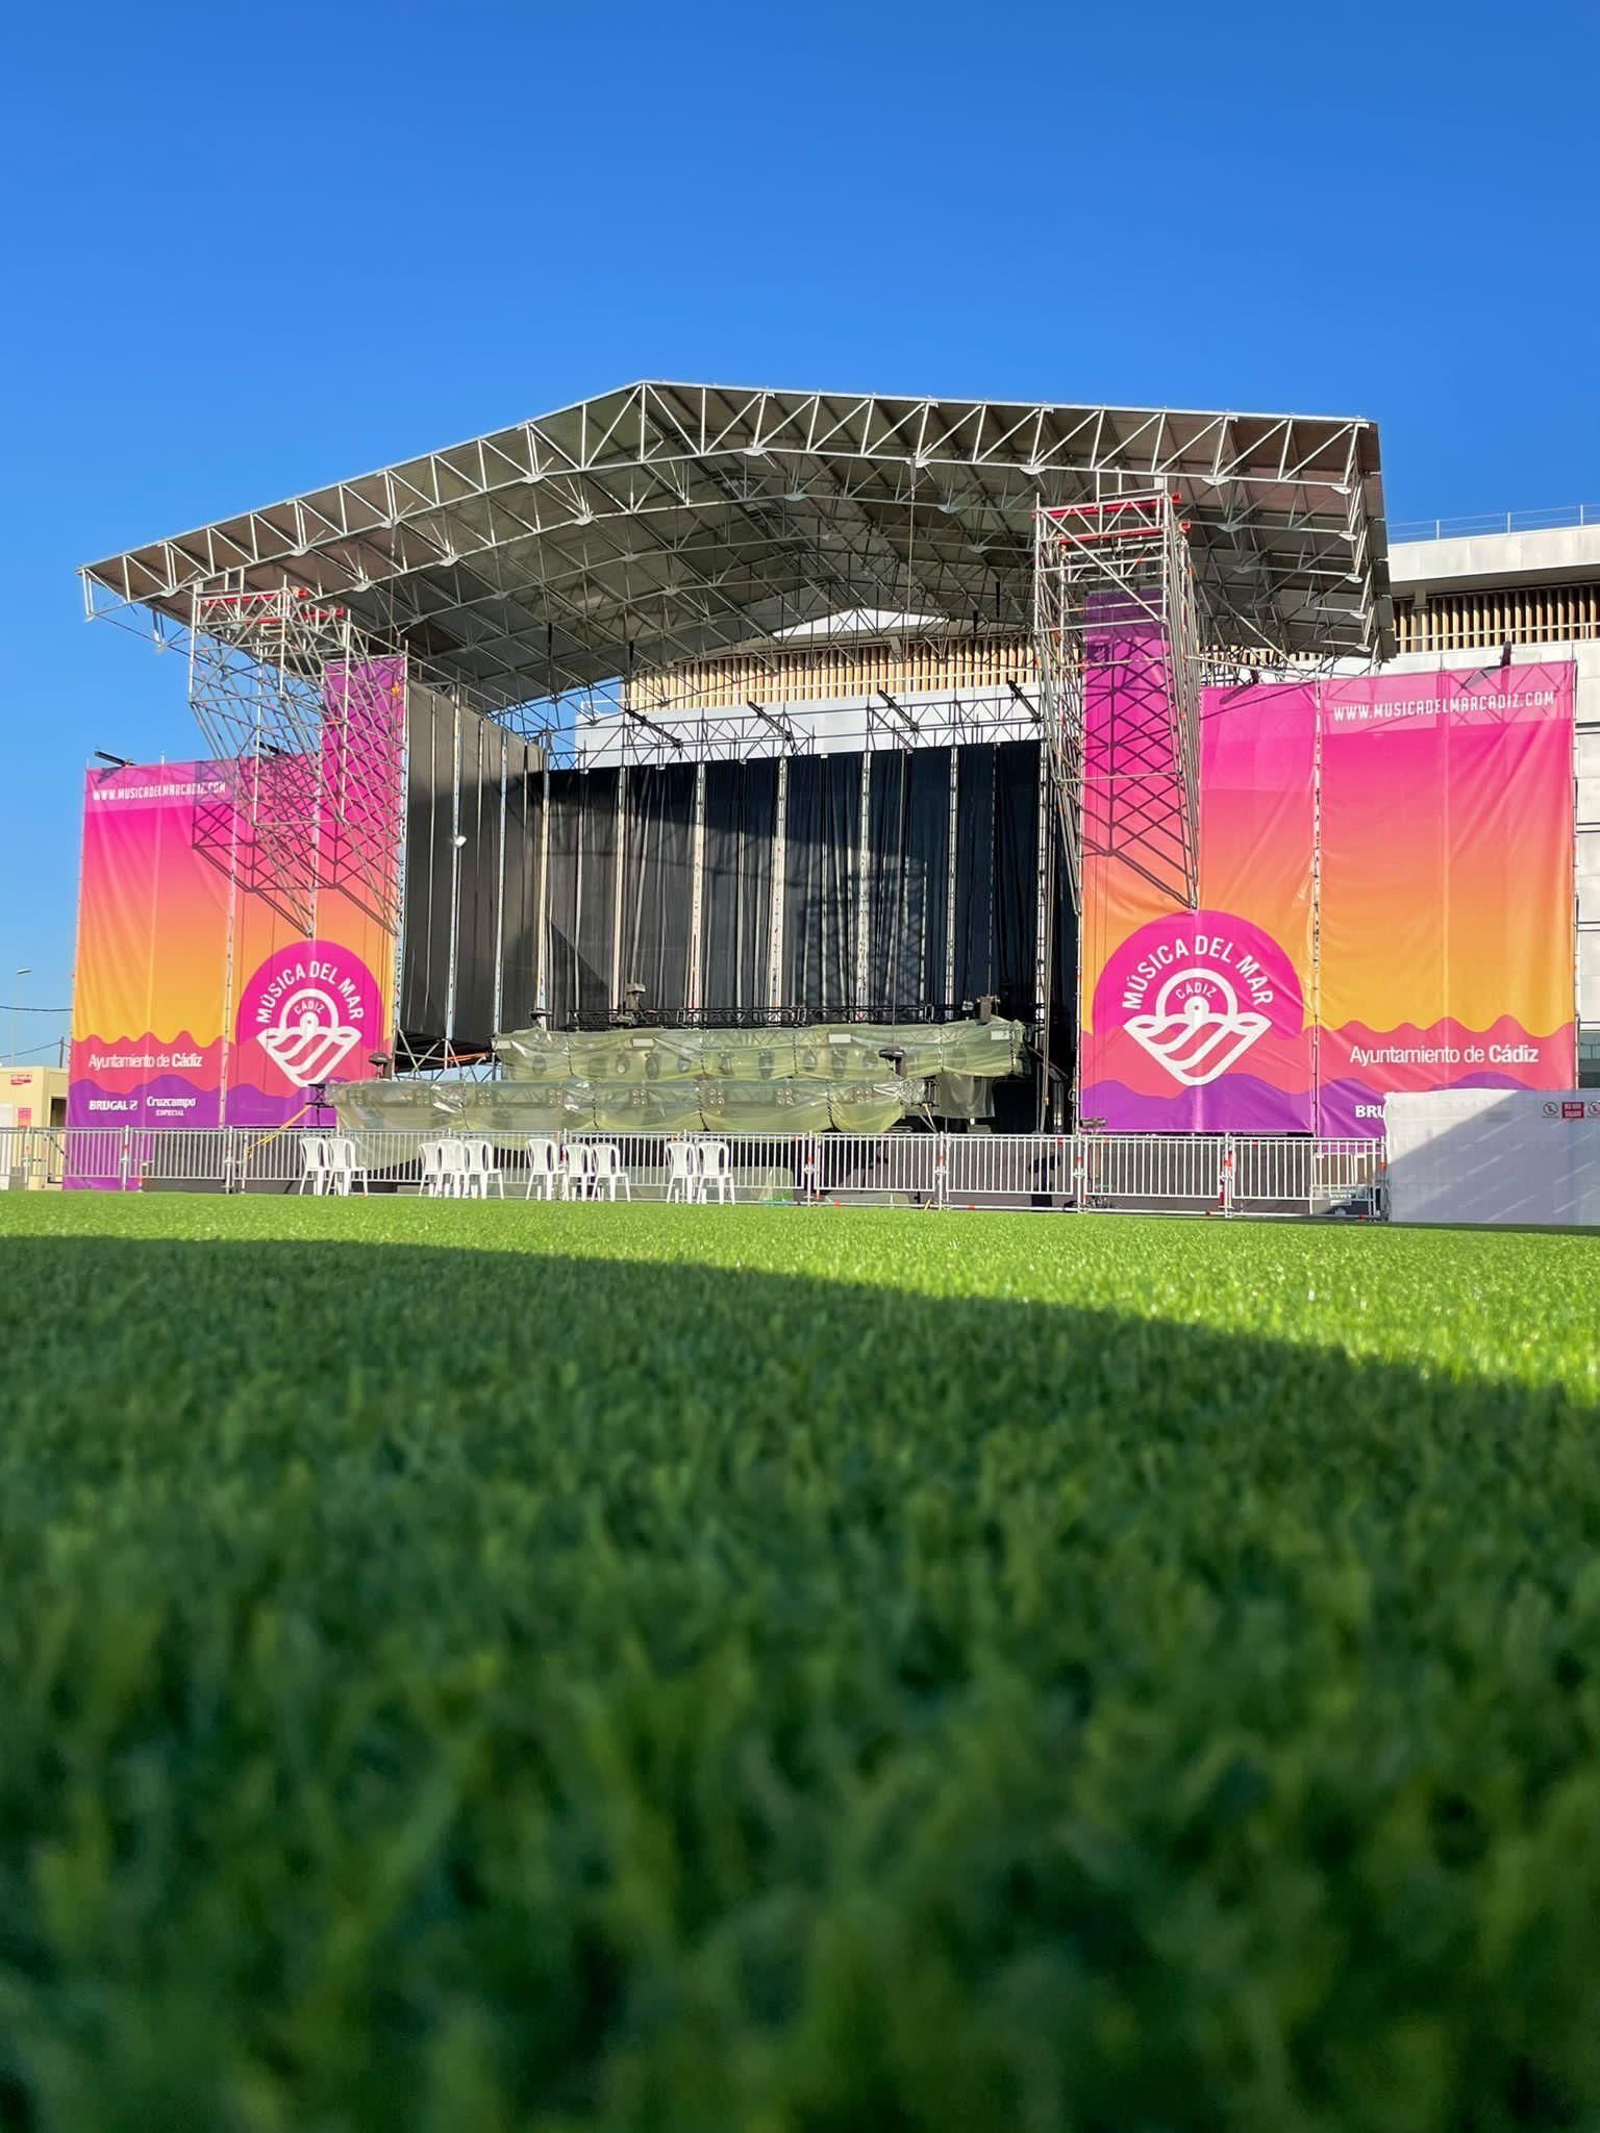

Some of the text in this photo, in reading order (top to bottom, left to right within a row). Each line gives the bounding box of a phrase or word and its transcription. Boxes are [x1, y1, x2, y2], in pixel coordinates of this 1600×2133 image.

[1333, 691, 1555, 722] WWW.MUSICADELMARCADIZ.COM
[1122, 935, 1274, 1010] MÚSICA DEL MAR
[256, 960, 364, 1023] MÚSICA DEL MAR
[88, 1052, 203, 1071] Ayuntamiento de Cádiz
[1350, 1044, 1540, 1067] Ayuntamiento de Cádiz
[89, 1100, 129, 1111] BRUGAL
[146, 1096, 197, 1109] Cruzcampo
